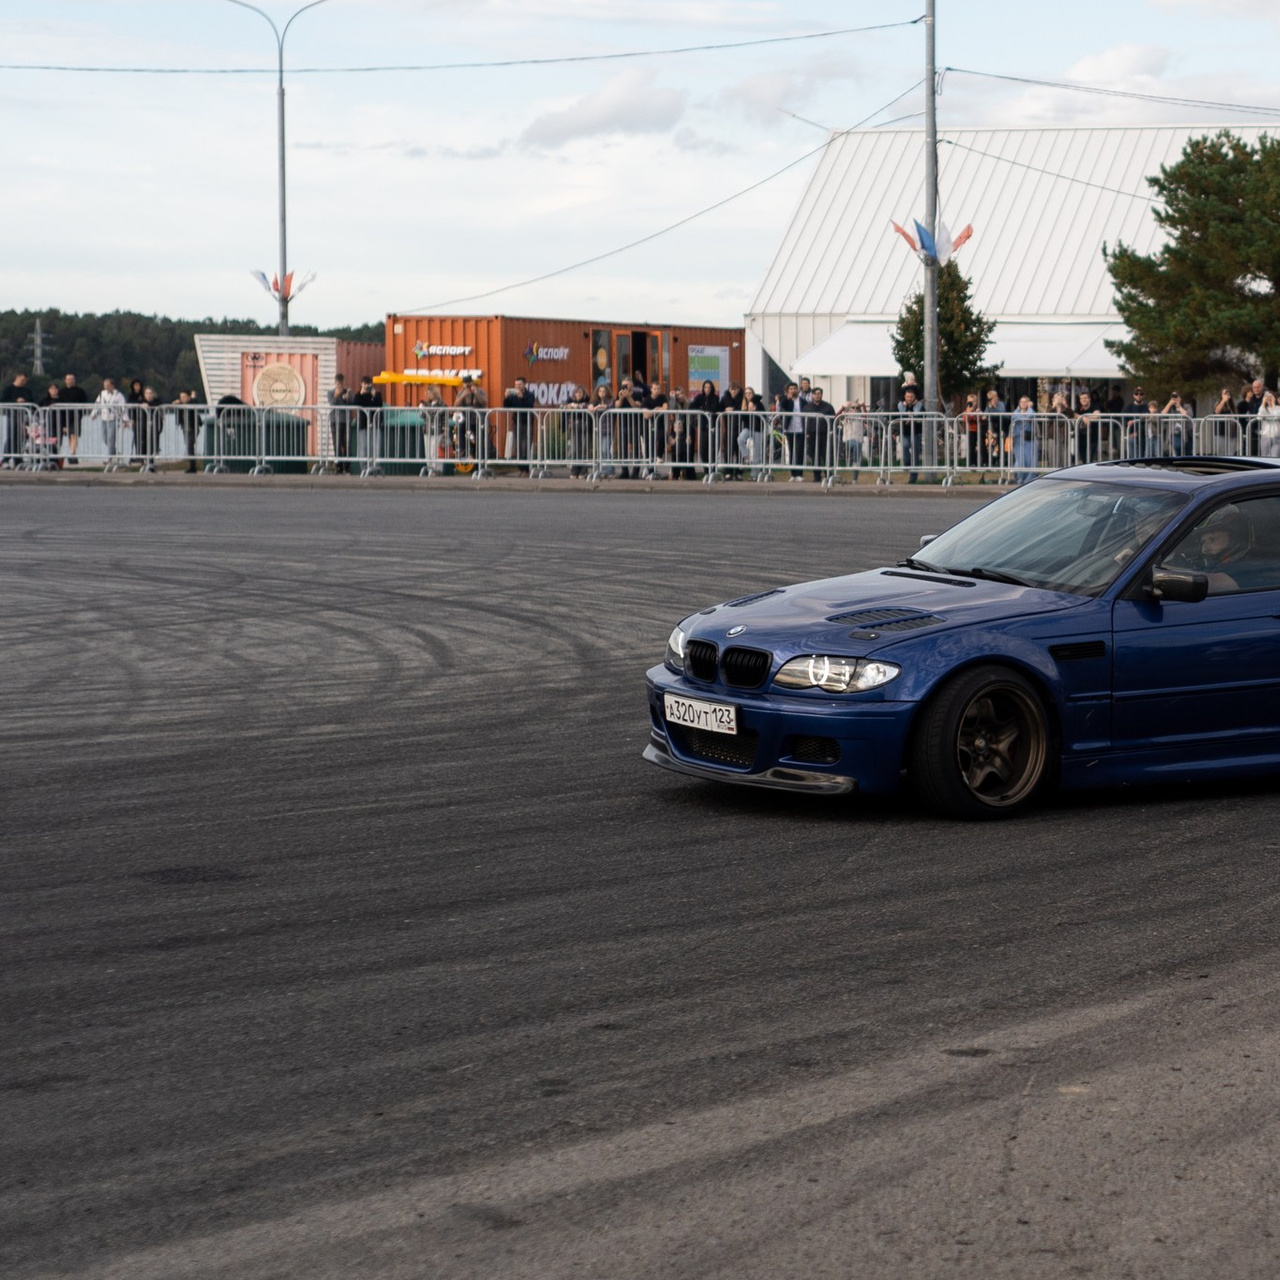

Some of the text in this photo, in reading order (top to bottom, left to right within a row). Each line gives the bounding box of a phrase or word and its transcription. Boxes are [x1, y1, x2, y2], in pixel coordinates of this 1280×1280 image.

[429, 345, 472, 356] ЯСПОРТ
[538, 346, 569, 360] ЯСПОРТ
[712, 707, 731, 724] 123
